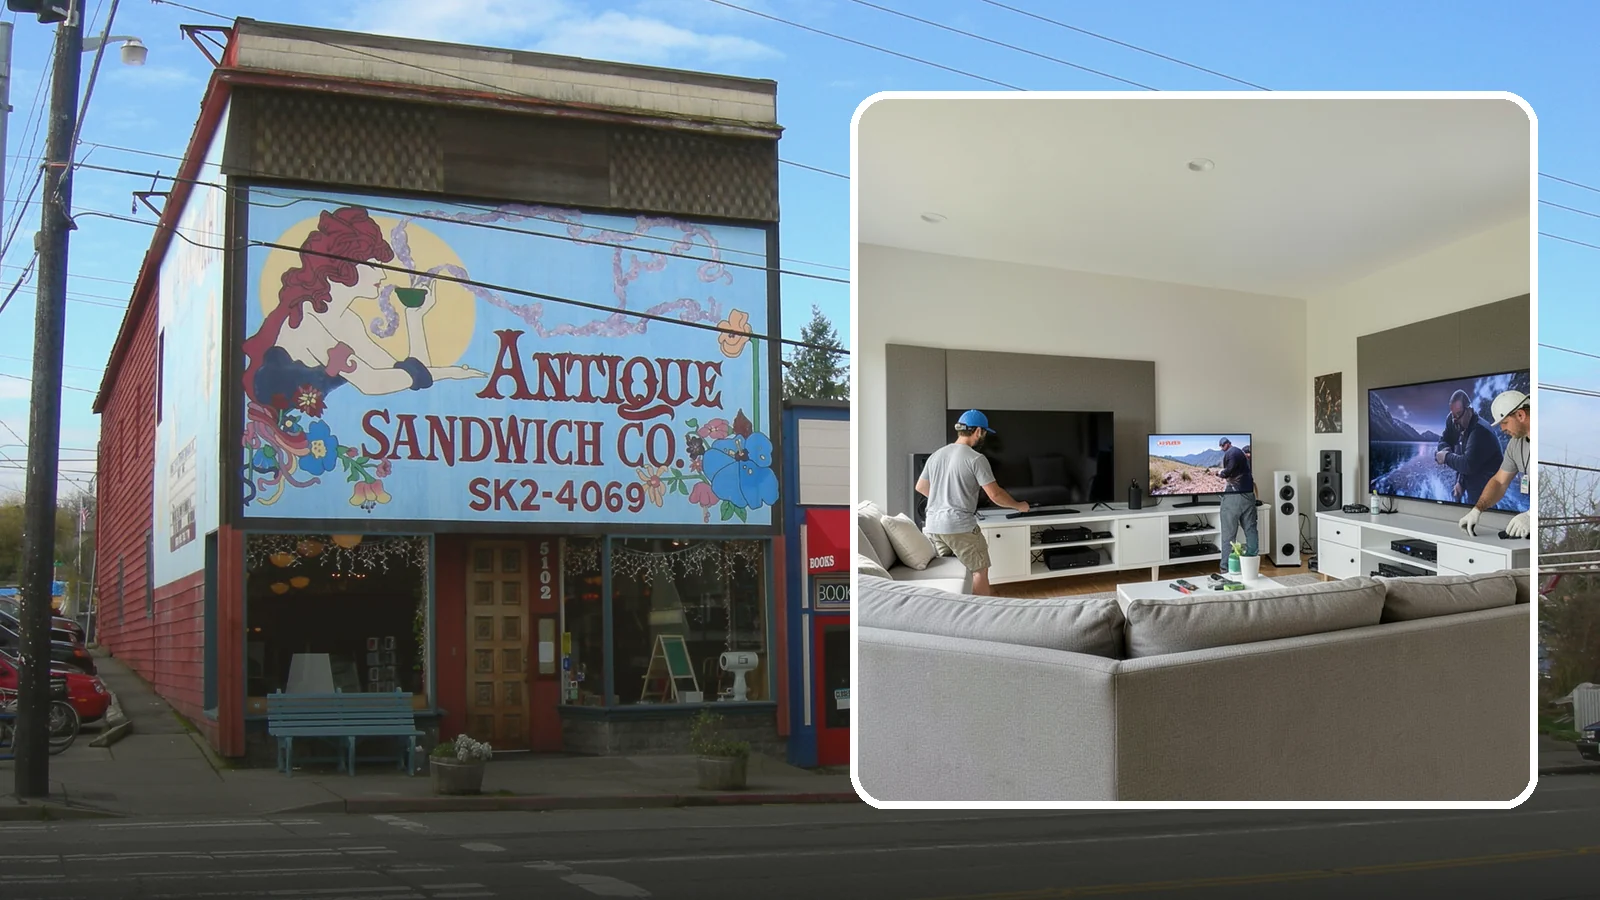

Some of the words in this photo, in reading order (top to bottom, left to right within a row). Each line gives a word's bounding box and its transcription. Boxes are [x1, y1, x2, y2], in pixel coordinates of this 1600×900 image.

[476, 329, 723, 420] ANTIQUE
[361, 408, 604, 467] SANDWICH
[617, 422, 685, 468] CO.
[468, 477, 645, 512] SK2-4069
[540, 541, 551, 599] 5102
[809, 555, 835, 569] BOOKS
